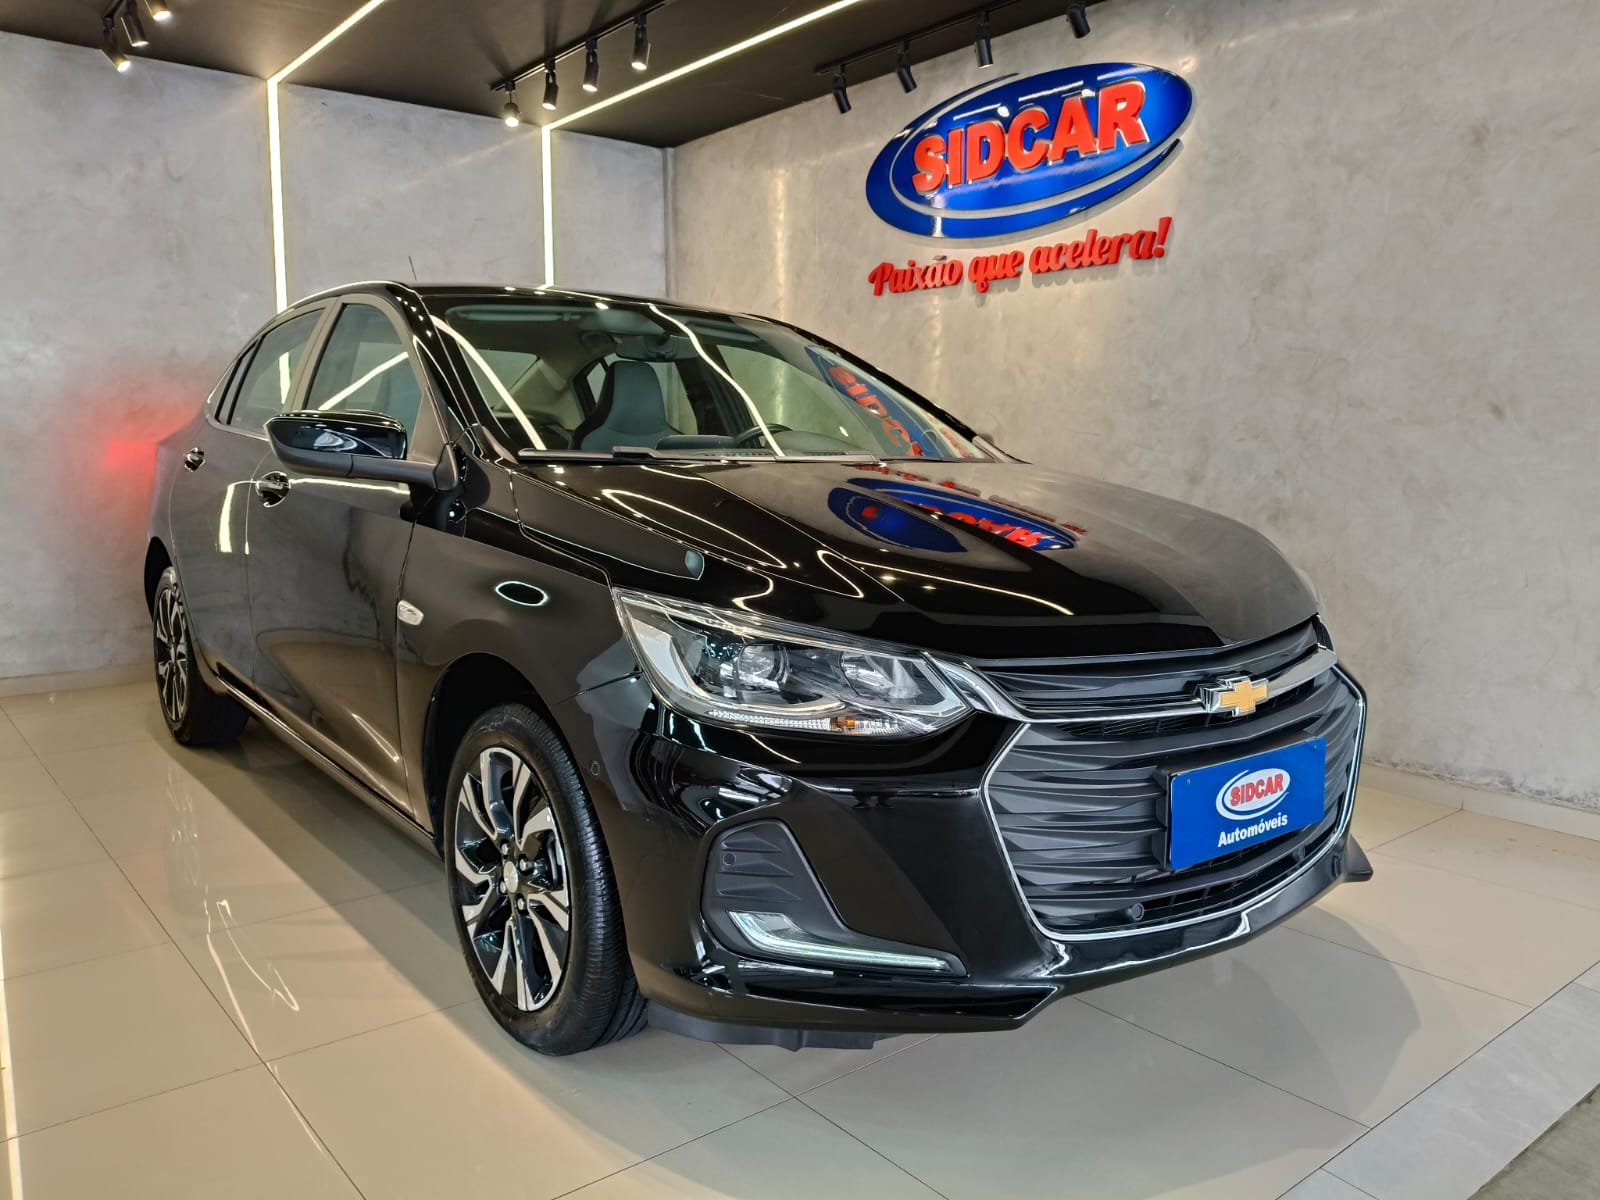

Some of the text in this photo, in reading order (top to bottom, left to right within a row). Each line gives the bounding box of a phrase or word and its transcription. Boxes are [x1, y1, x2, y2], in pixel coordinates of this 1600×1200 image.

[912, 80, 1149, 192] SIDCAR
[868, 217, 1172, 296] Paixão que acelera!
[1230, 773, 1284, 807] SIDCAR
[1217, 812, 1288, 848] Automóveis
